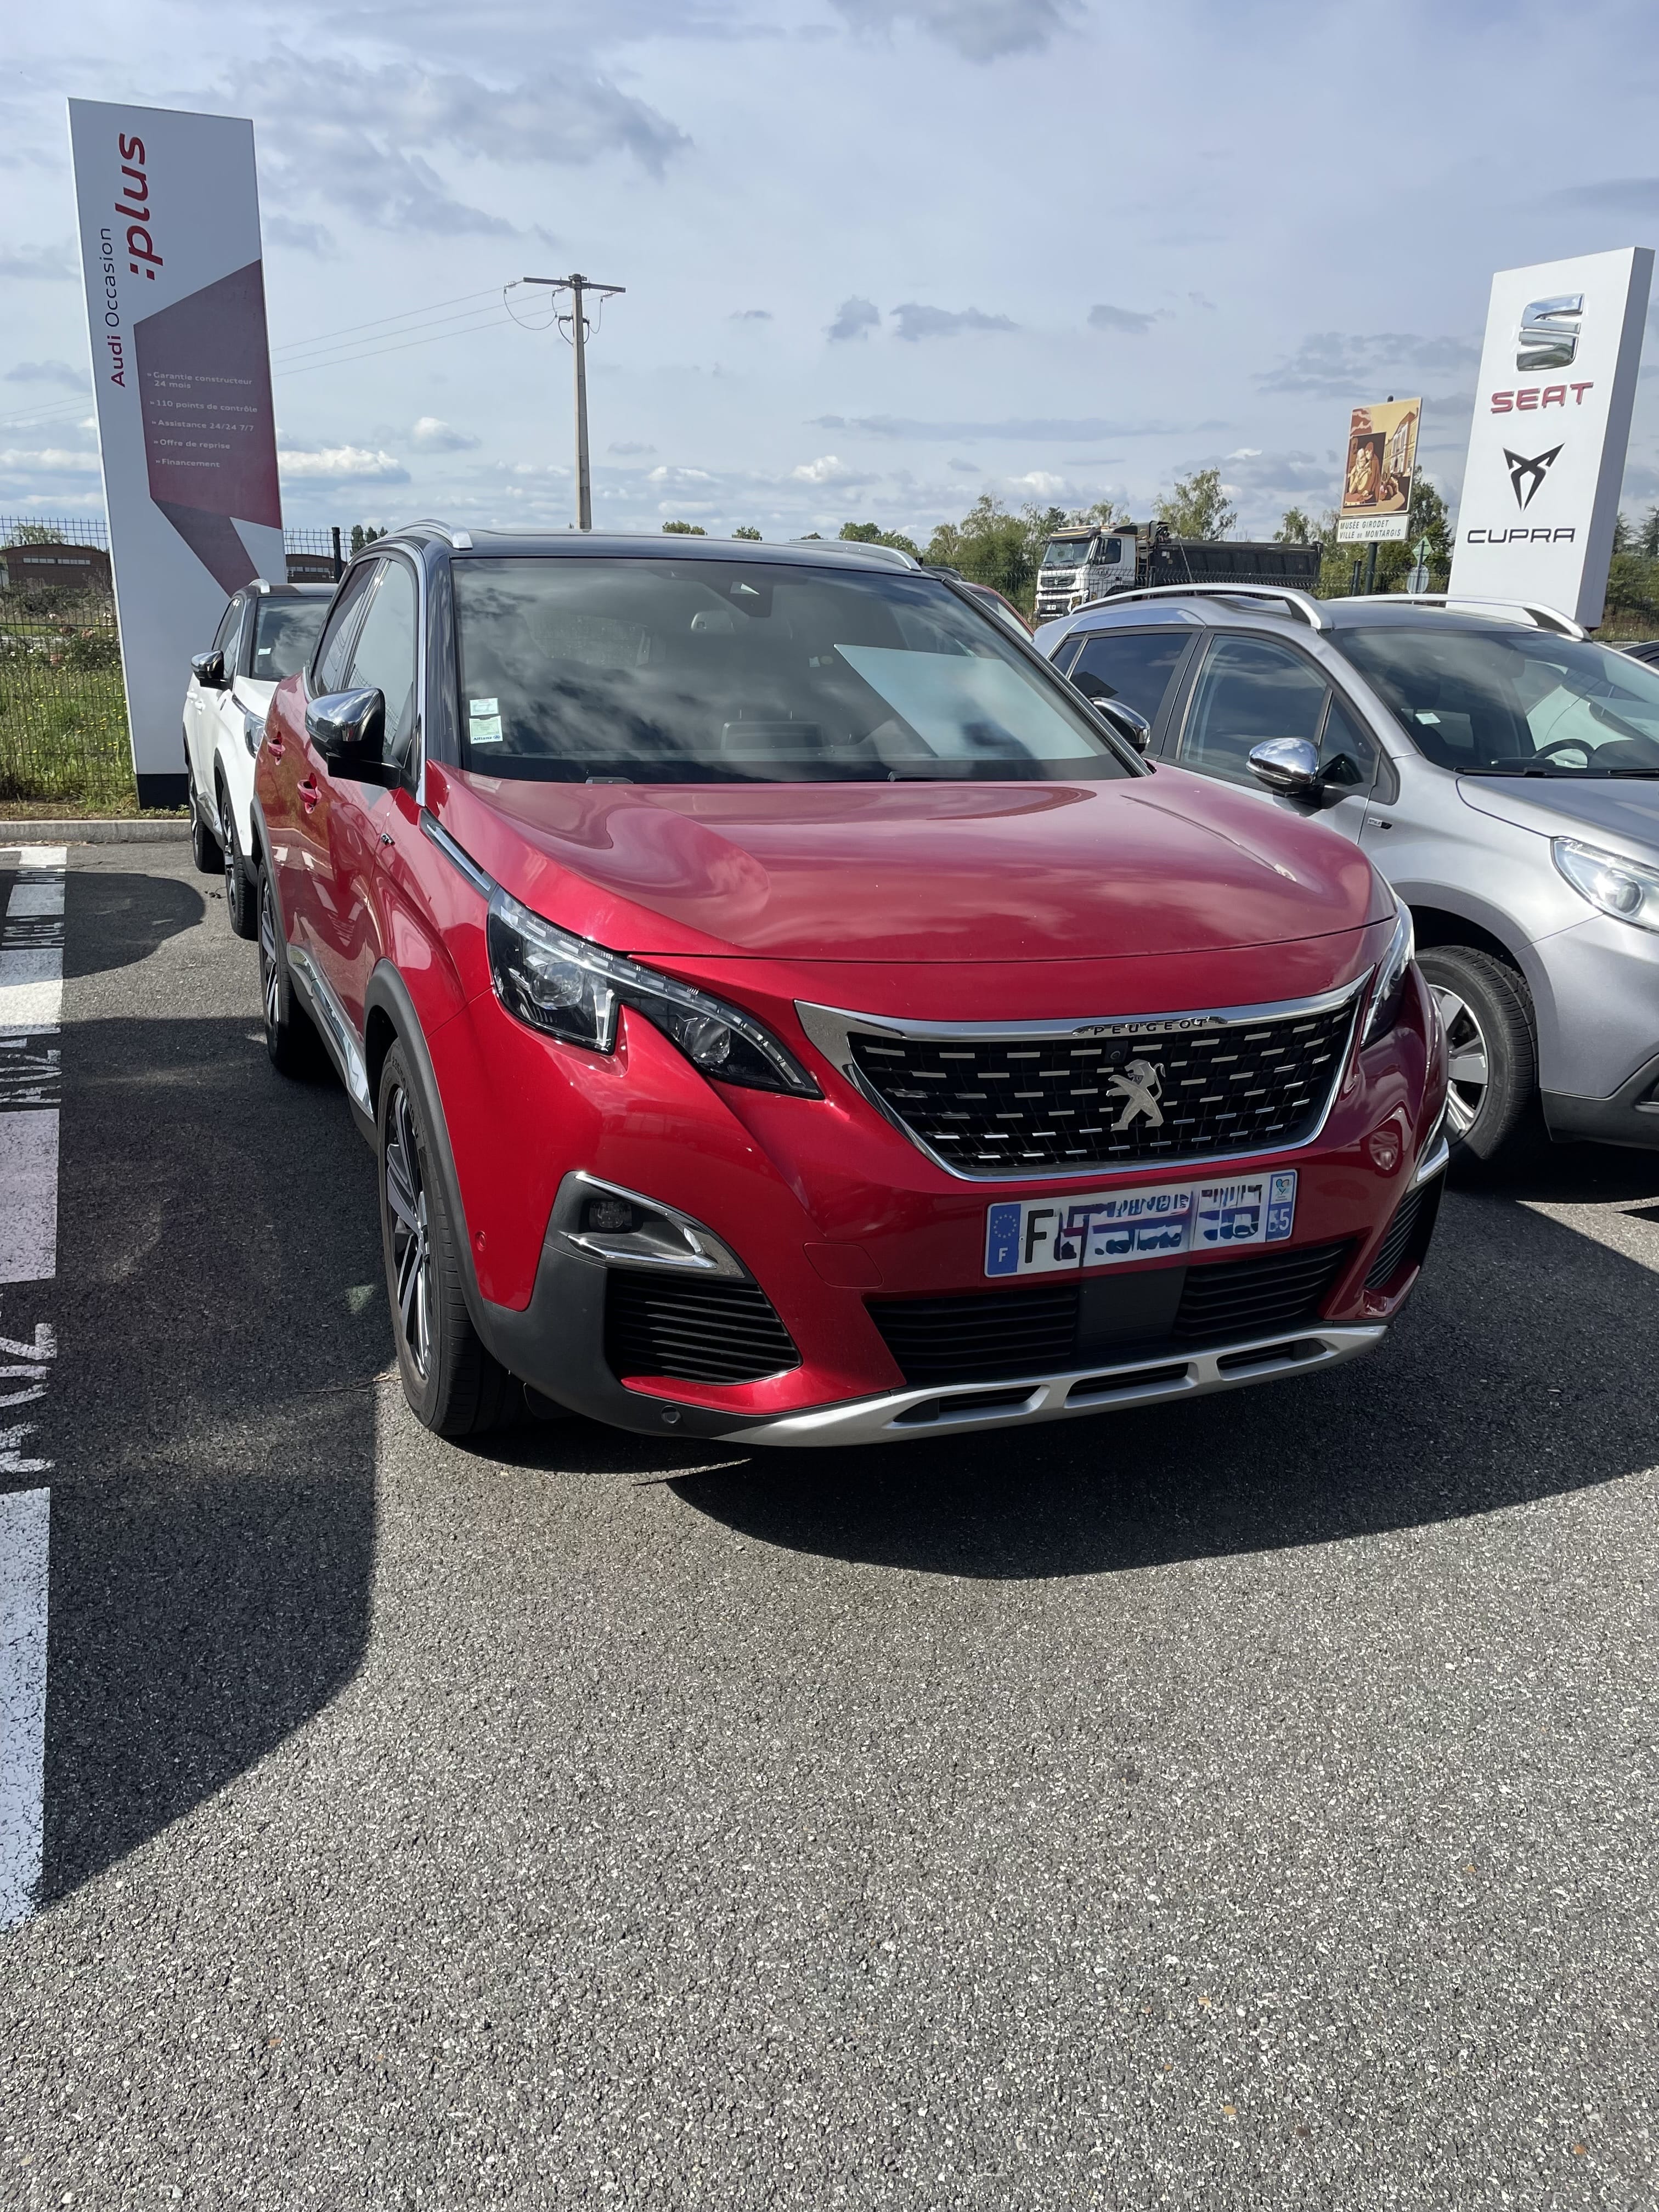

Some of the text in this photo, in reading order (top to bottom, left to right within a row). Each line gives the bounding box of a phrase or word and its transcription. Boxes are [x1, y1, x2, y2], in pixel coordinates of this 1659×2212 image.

[99, 228, 126, 387] Audi Occasion
[153, 371, 252, 385] Garantie constructeur
[1491, 382, 1593, 413] SEAT
[158, 420, 207, 428] Assistance
[162, 459, 220, 467] Financement
[1340, 520, 1389, 529] MUSÉE GIRODET
[1365, 529, 1401, 538] MONTARGIS
[1467, 528, 1576, 544] CUPRA
[1093, 1018, 1207, 1035] PEUGEOT
[998, 1248, 1009, 1262] F
